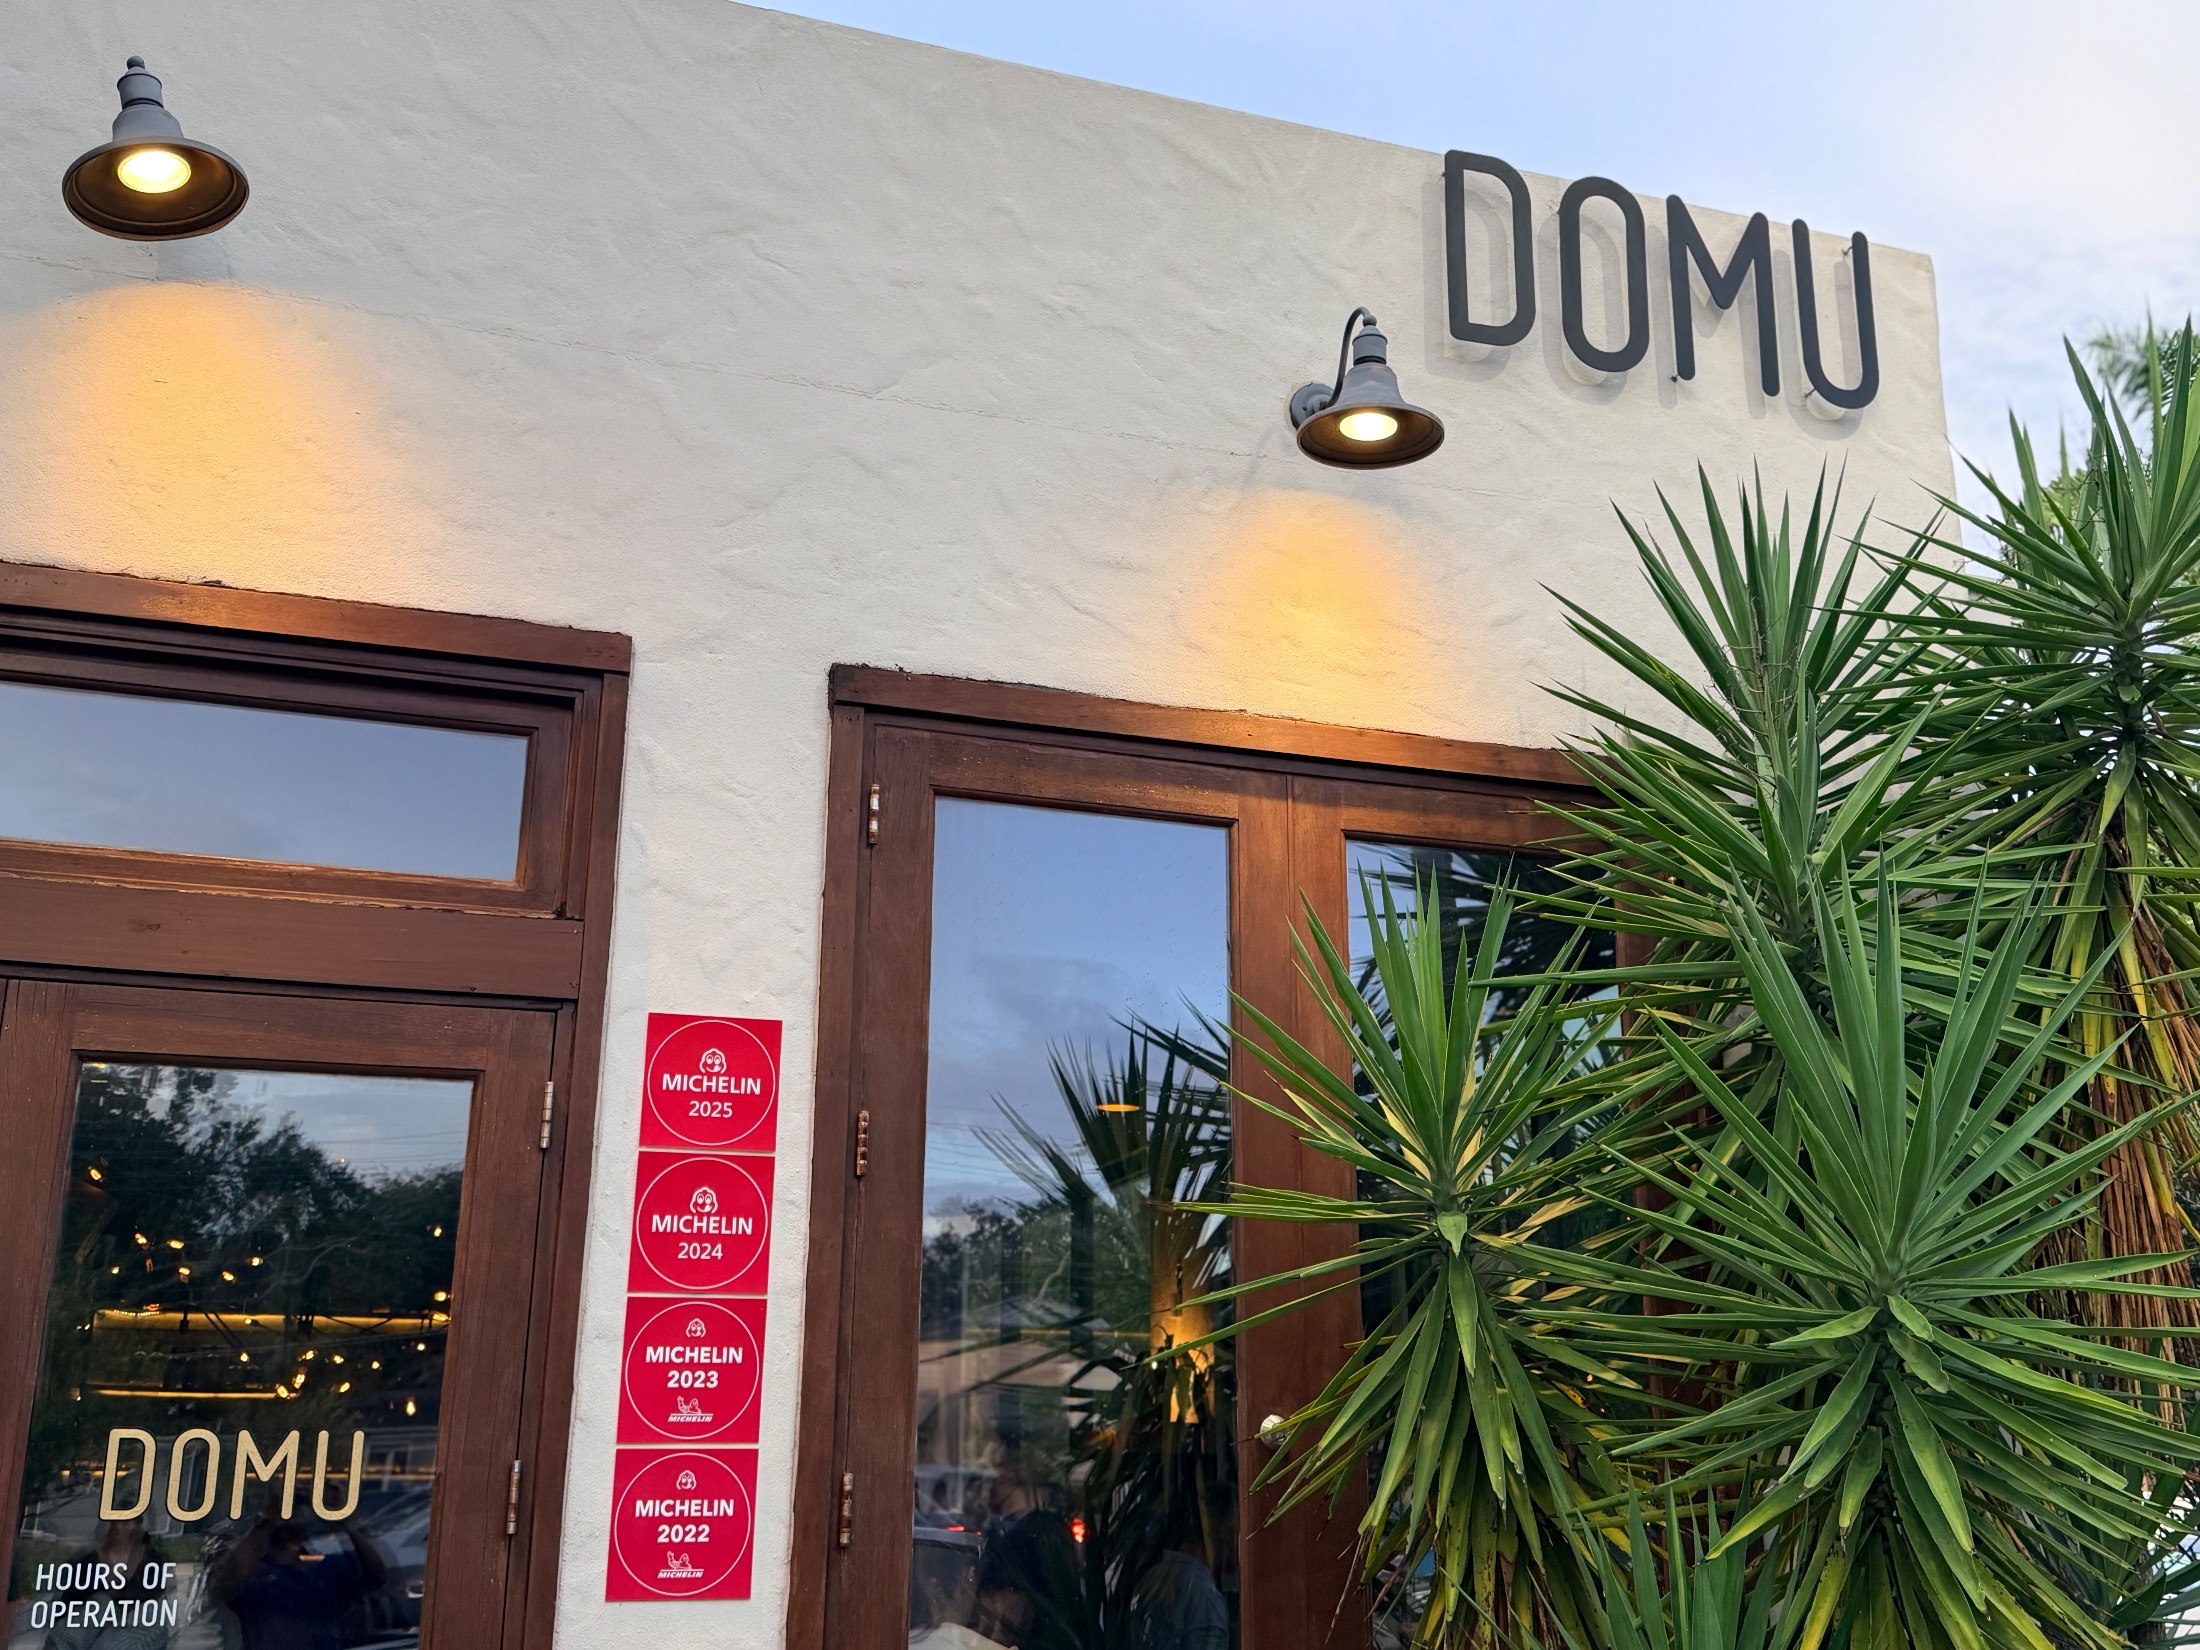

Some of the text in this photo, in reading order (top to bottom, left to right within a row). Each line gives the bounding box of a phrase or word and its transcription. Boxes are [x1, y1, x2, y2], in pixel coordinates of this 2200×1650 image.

[1445, 149, 1879, 409] DOMU
[661, 1073, 761, 1095] MICHELIN
[688, 1101, 733, 1118] 2025
[651, 1214, 753, 1235] MICHELIN
[677, 1242, 723, 1260] 2024
[645, 1346, 743, 1364] MICHELIN
[667, 1370, 719, 1388] 2023
[668, 1415, 713, 1423] MICHELIN
[100, 1428, 365, 1521] DOMU
[635, 1499, 735, 1517] MICHELIN
[657, 1524, 710, 1543] 2022
[35, 1562, 177, 1591] HOURS OF
[657, 1570, 704, 1579] MICHELIN
[30, 1599, 178, 1629] OPERATION
